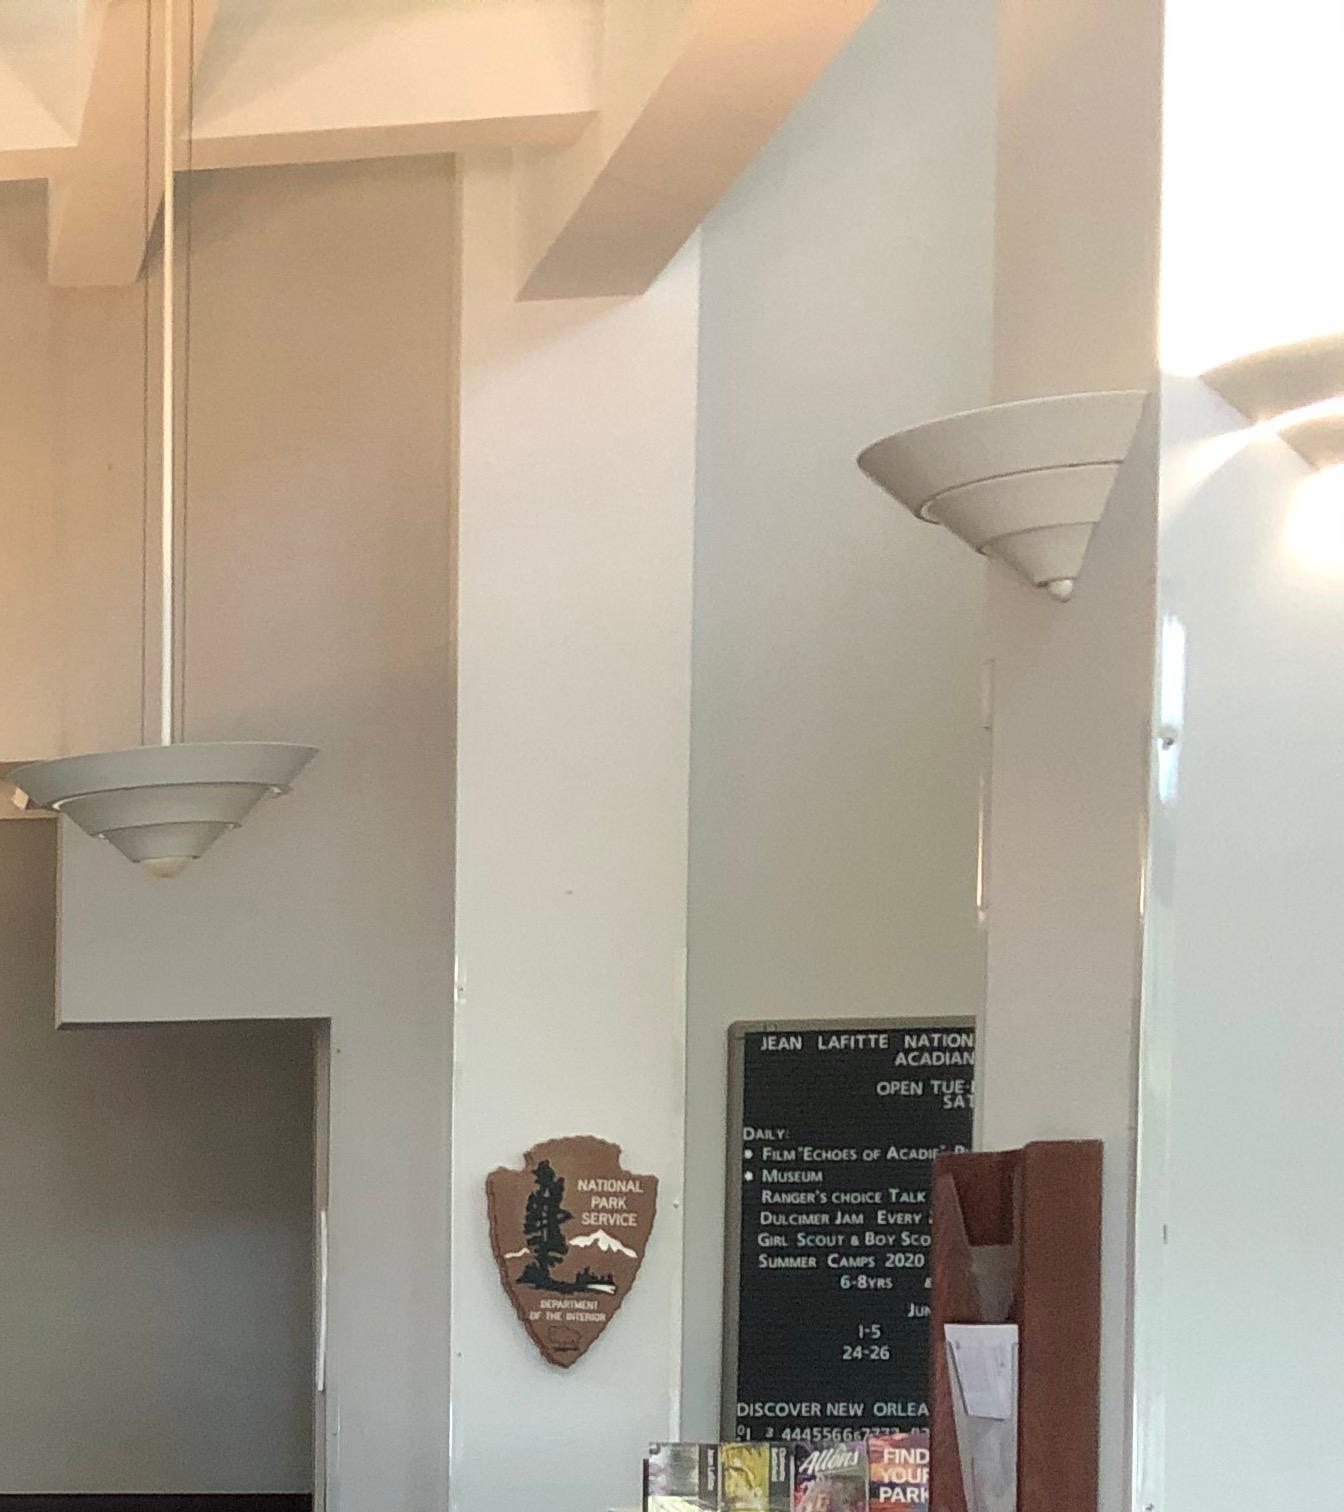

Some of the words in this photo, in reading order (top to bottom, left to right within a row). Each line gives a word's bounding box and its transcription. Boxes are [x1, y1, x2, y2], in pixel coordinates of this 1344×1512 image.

[761, 1035, 803, 1050] JEAN
[818, 1034, 889, 1050] LAFITTE
[904, 1033, 975, 1048] NATION
[876, 1081, 923, 1096] OPEN
[762, 1147, 796, 1161] FILM
[863, 1148, 880, 1161] OF
[762, 1168, 824, 1182] MUSEUM
[577, 1179, 644, 1193] NATIONAL
[591, 1196, 628, 1210] PARK
[762, 1189, 828, 1204] RANGER'S
[831, 1191, 883, 1204] CHOICE
[888, 1188, 927, 1203] TALK
[581, 1212, 638, 1227] SERVICE
[760, 1211, 830, 1226] DULCIMER
[834, 1210, 864, 1225] JAM
[877, 1210, 923, 1224] EVERY
[758, 1232, 788, 1247] GIRL
[797, 1232, 845, 1247] SCOUT
[850, 1235, 859, 1247] &
[865, 1231, 896, 1247] BOY
[759, 1253, 817, 1268] SUMMER
[827, 1253, 876, 1268] CAMPS
[885, 1253, 925, 1268] 2020
[840, 1274, 894, 1289] 6-8YRS
[540, 1299, 599, 1310] DEPARTMENT
[529, 1310, 543, 1320] OF
[546, 1311, 563, 1321] THE
[566, 1312, 607, 1322] INTERIOR
[842, 1345, 891, 1360] 24-26
[736, 1402, 822, 1417] DISCOVER
[826, 1402, 864, 1417] NEW
[873, 1402, 930, 1417] ORLEA
[883, 1448, 930, 1464] FIND
